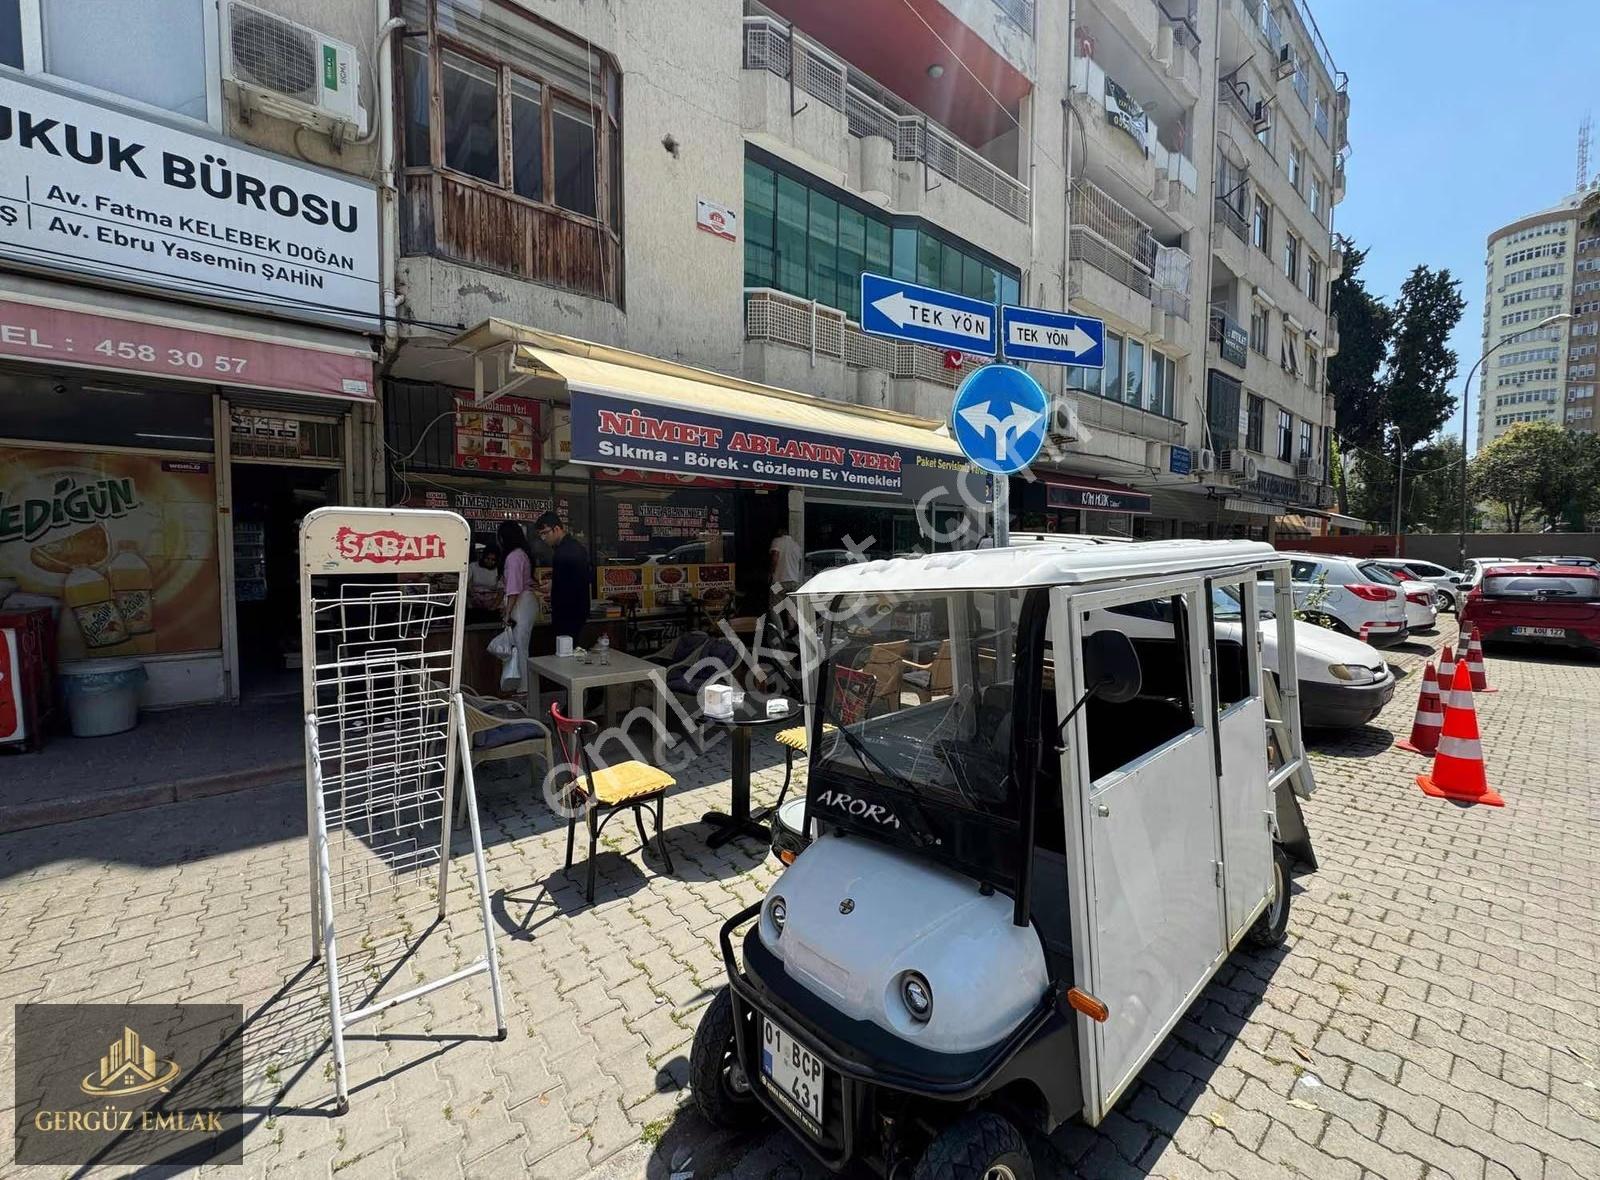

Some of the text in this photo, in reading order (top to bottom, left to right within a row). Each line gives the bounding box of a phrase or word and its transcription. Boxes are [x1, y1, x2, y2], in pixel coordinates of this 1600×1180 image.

[162, 151, 358, 233] BÜROSU
[47, 185, 354, 271] Av. Fatma KELEBEK DOĞAN
[49, 216, 89, 239] Av.
[97, 226, 155, 253] Ebru
[161, 240, 256, 275] Yasemin
[262, 263, 324, 289] ŞAHİN
[909, 305, 985, 335] TEK YÖN
[1017, 328, 1068, 346] TEK YÖN
[95, 339, 156, 362] 458
[168, 349, 203, 368] 30
[215, 355, 248, 374] 57
[598, 409, 723, 449] NİMET
[727, 432, 846, 465] ABLANIN
[849, 449, 902, 472] YERİ
[916, 455, 937, 468] Paket
[598, 440, 668, 463] Sıkma
[684, 451, 739, 471] Börek
[752, 460, 819, 478] Gözleme
[822, 468, 838, 481] Ev
[841, 470, 901, 488] Yemekleri
[0, 477, 137, 540] EDİGÜN
[342, 533, 440, 557] SABAH
[817, 790, 900, 829] ARORA
[765, 1022, 820, 1082] 01 BCP
[792, 1076, 819, 1118] 431
